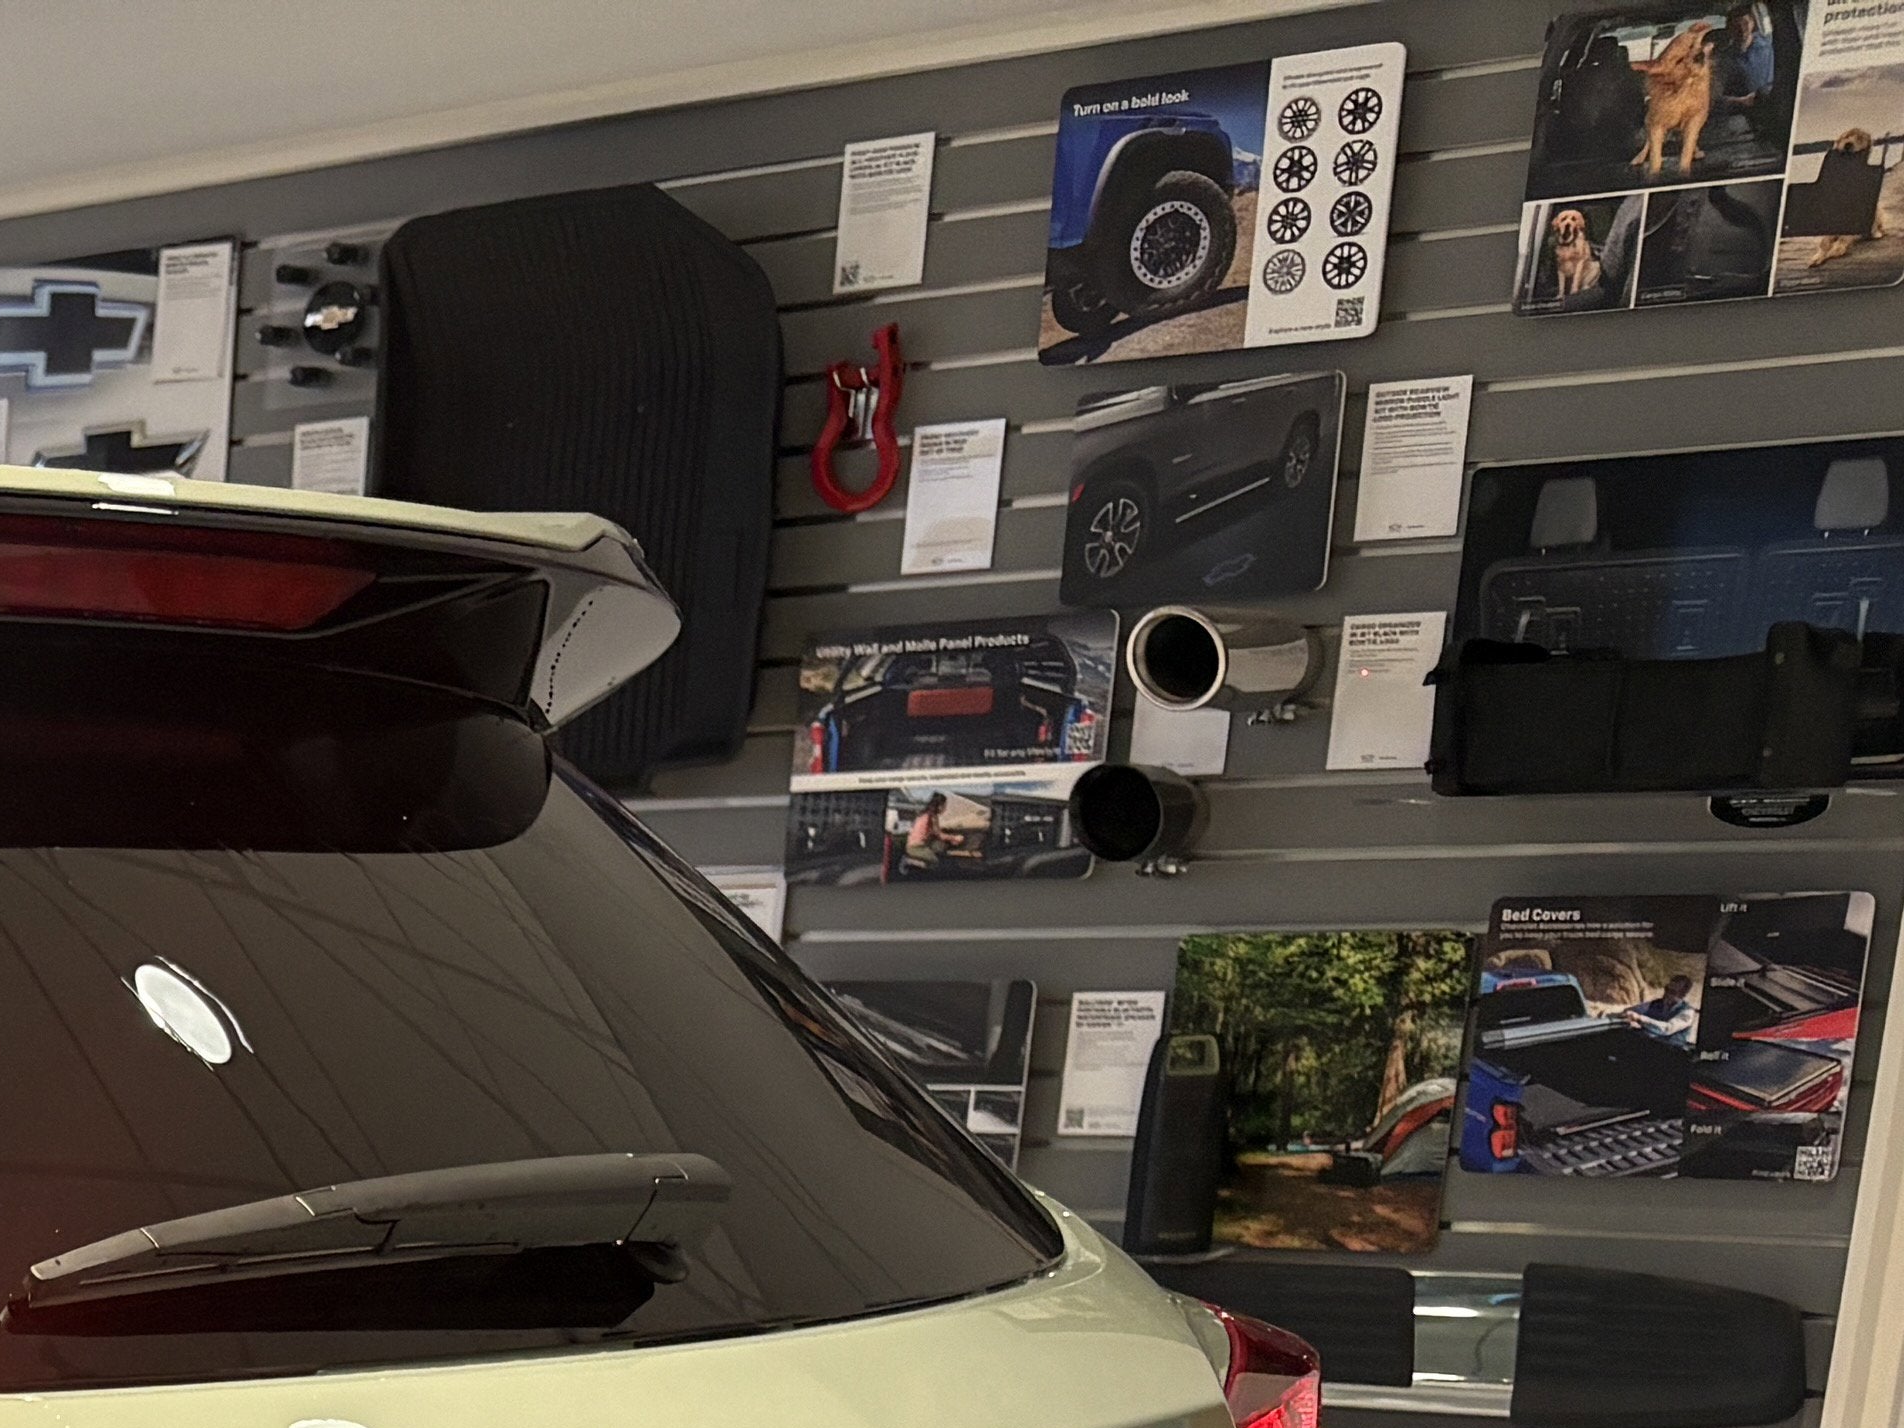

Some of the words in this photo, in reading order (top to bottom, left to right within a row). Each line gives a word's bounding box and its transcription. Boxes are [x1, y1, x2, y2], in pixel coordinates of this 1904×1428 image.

[1073, 103, 1100, 117] Turn
[1102, 101, 1119, 113] on
[1121, 100, 1129, 110] a
[1131, 93, 1159, 109] bold
[1161, 89, 1189, 104] look
[974, 633, 1030, 647] Products
[1502, 908, 1530, 922] Bed
[1532, 909, 1581, 921] Covers
[1720, 903, 1739, 913] Lift
[1740, 903, 1747, 912] it
[1690, 1124, 1711, 1134] Fold
